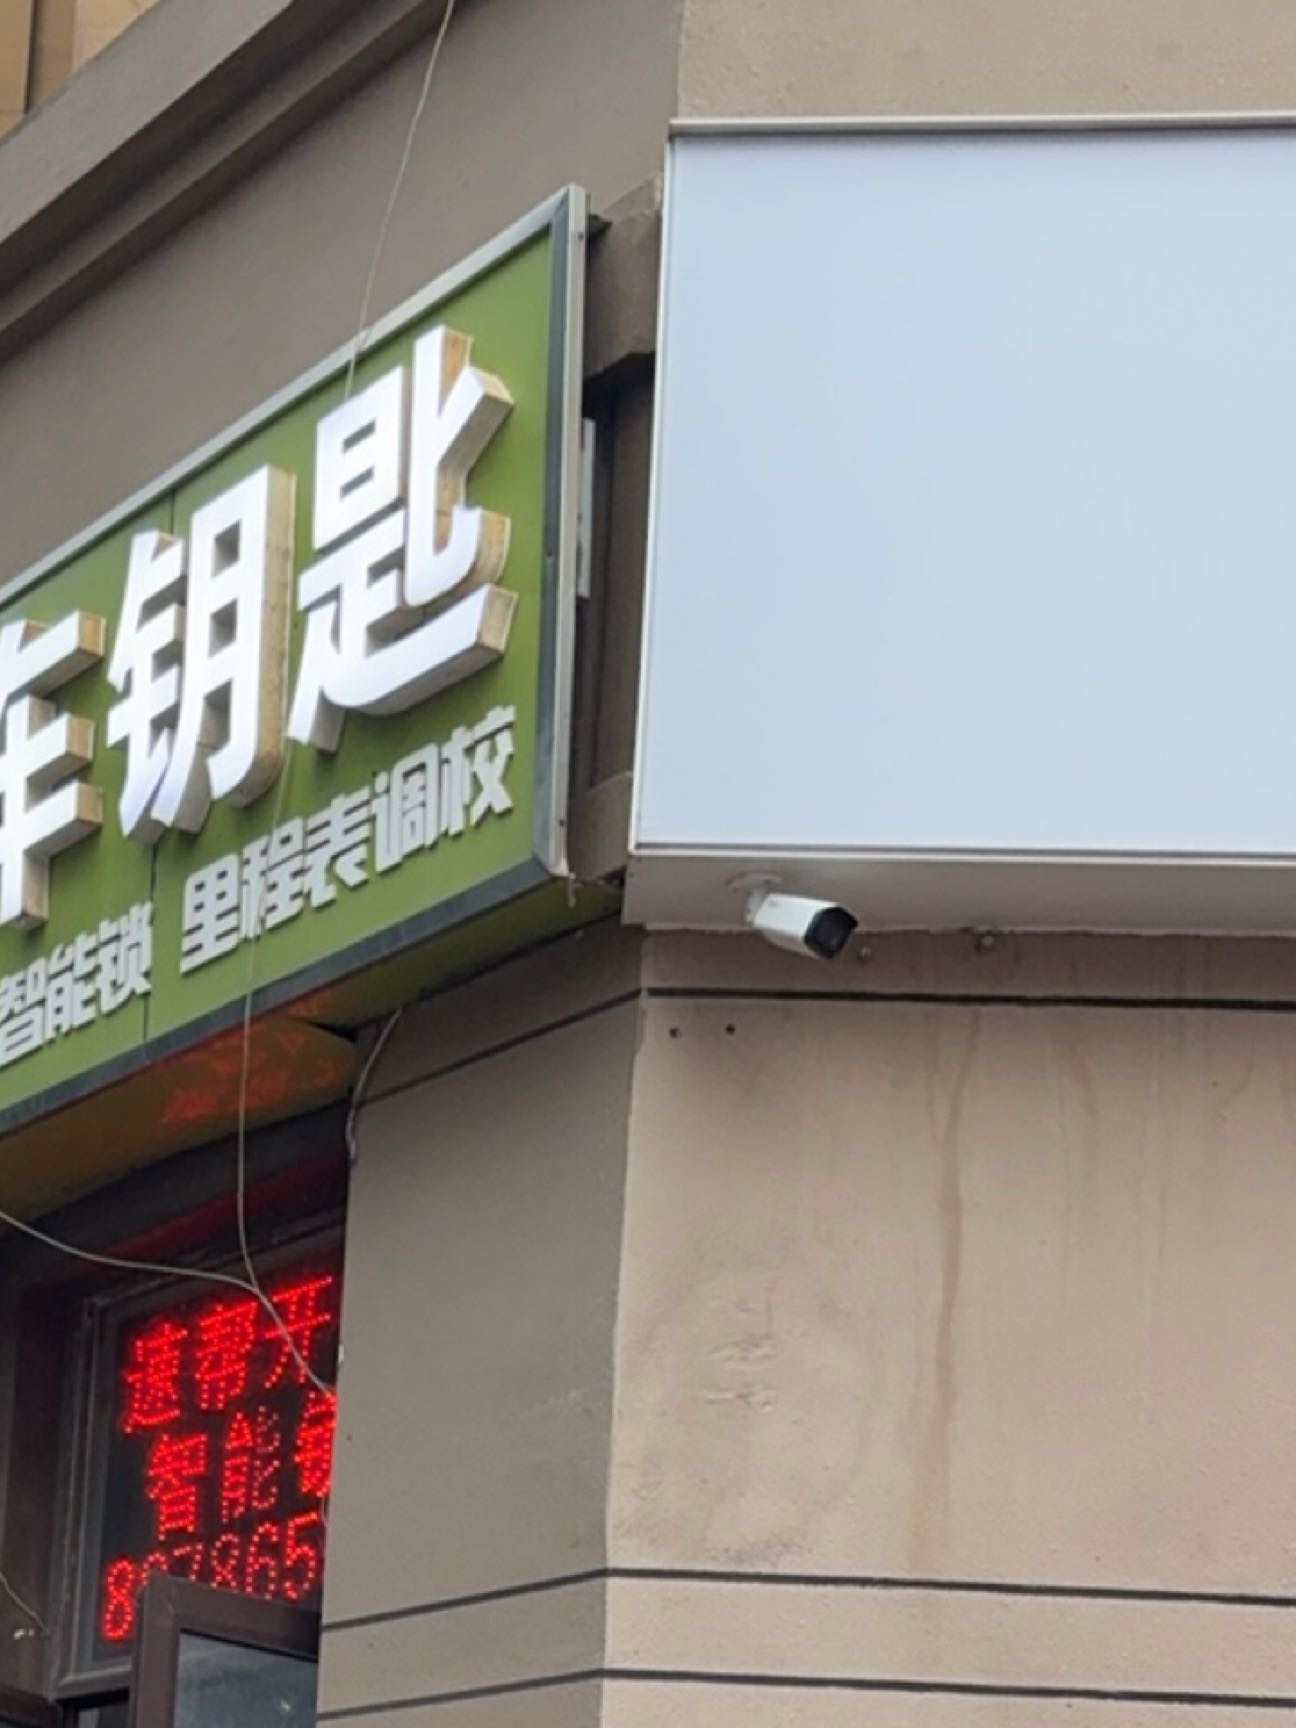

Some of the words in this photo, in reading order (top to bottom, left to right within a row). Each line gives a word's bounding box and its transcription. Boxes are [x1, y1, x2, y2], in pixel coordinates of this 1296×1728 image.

[180, 706, 516, 975] 里程表调校
